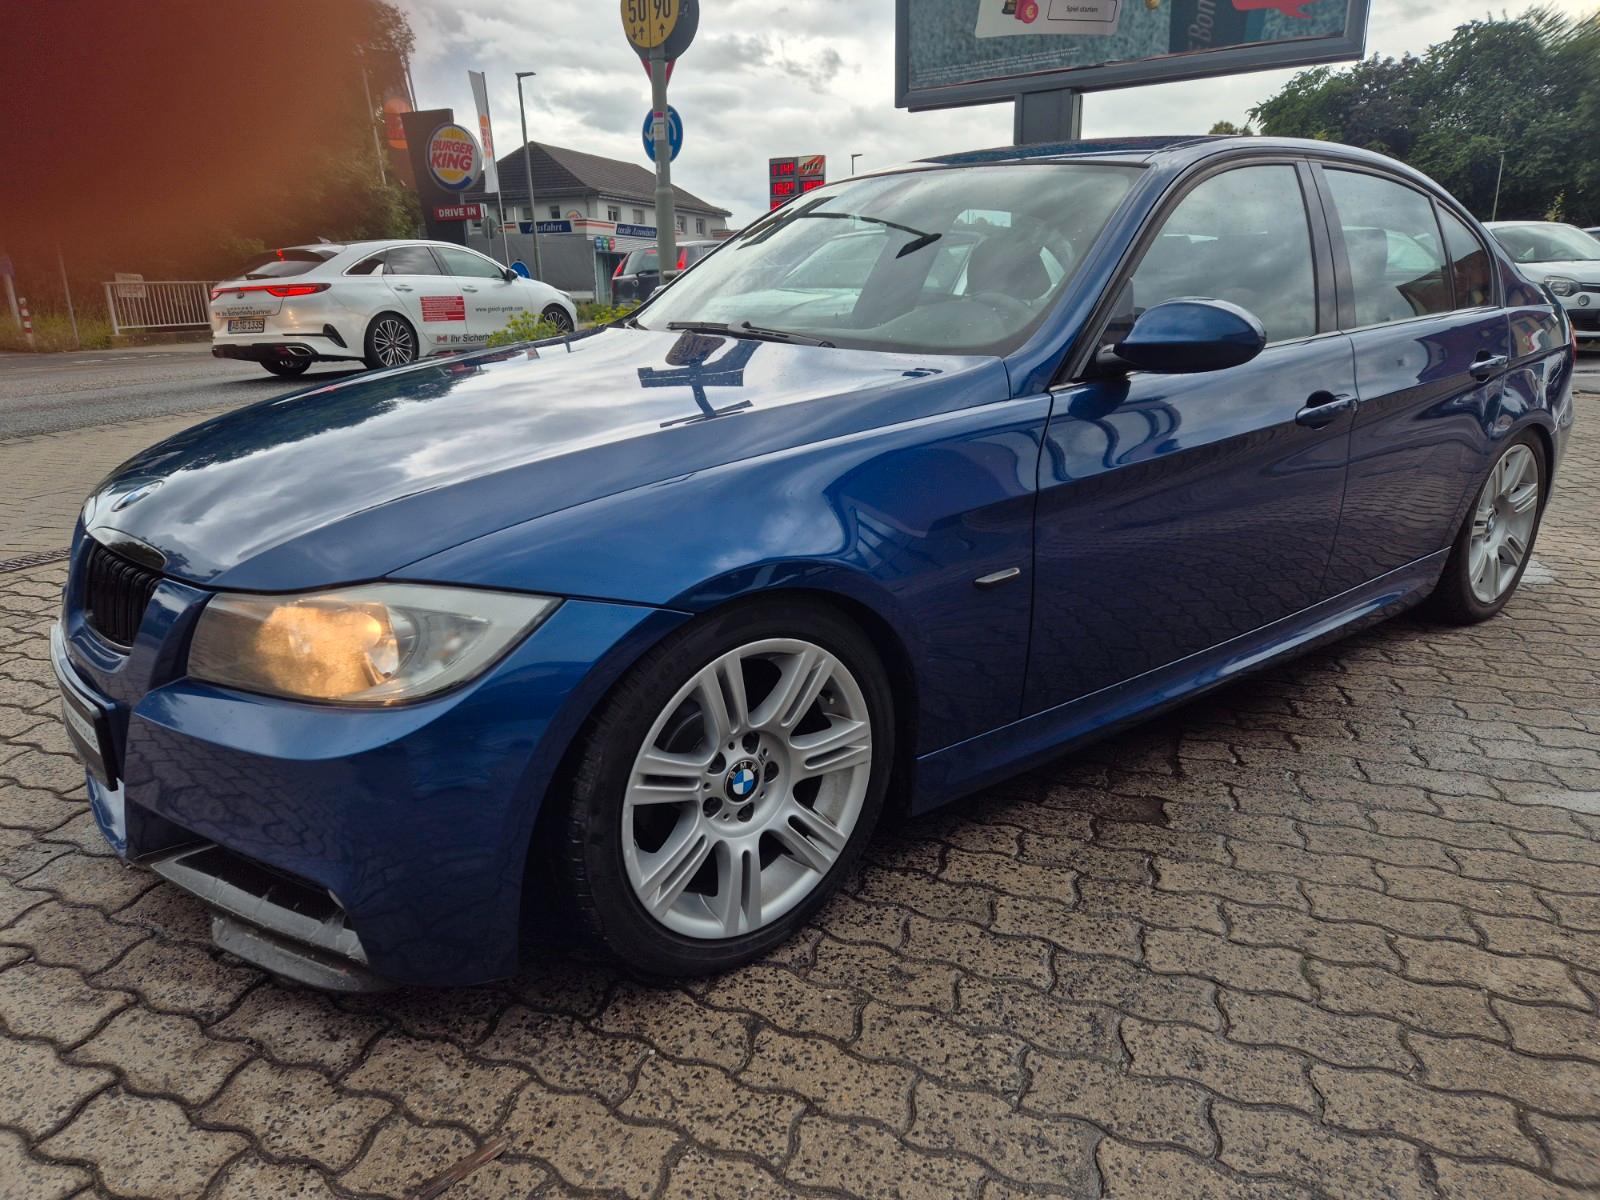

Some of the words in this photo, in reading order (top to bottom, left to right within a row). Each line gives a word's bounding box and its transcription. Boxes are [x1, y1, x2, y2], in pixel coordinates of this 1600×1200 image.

[628, 0, 646, 23] 50
[653, 0, 671, 20] 90
[1066, 5, 1079, 13] Spiel
[1079, 5, 1098, 13] starten
[431, 140, 474, 155] BURGER
[431, 152, 473, 171] KING
[438, 208, 464, 217] DRIVE
[466, 207, 477, 216] IN
[729, 760, 759, 780] BMW
